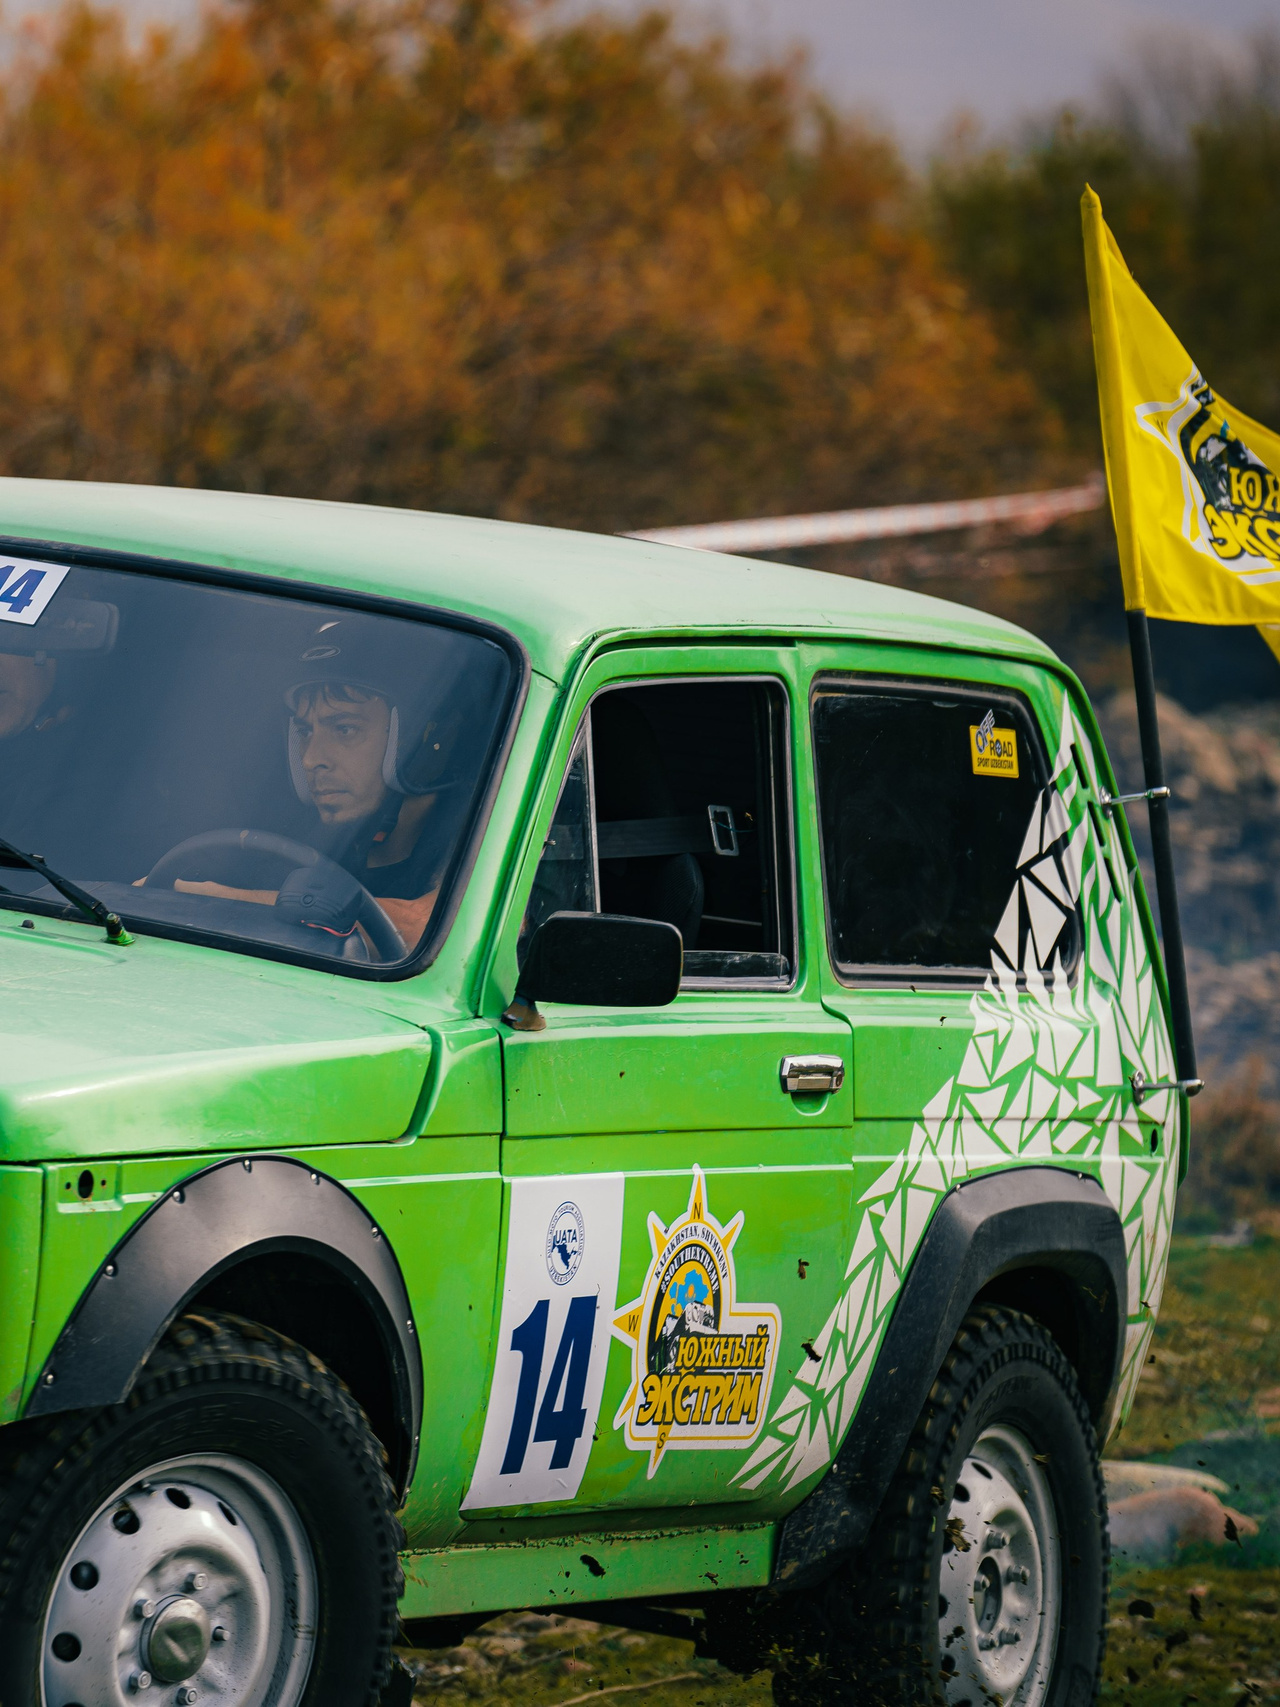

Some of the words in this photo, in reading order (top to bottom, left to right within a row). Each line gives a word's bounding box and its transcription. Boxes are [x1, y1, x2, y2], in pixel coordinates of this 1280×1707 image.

[975, 708, 996, 755] OFF
[989, 738, 1014, 758] ROAD
[977, 757, 990, 768] SPORT
[990, 758, 1014, 770] UZBEKISTAN
[555, 1228, 578, 1244] UATA
[674, 1323, 770, 1370] ЮЖНЫЙ
[498, 1294, 599, 1476] 14
[635, 1371, 763, 1426] ЭКСТРИМ
